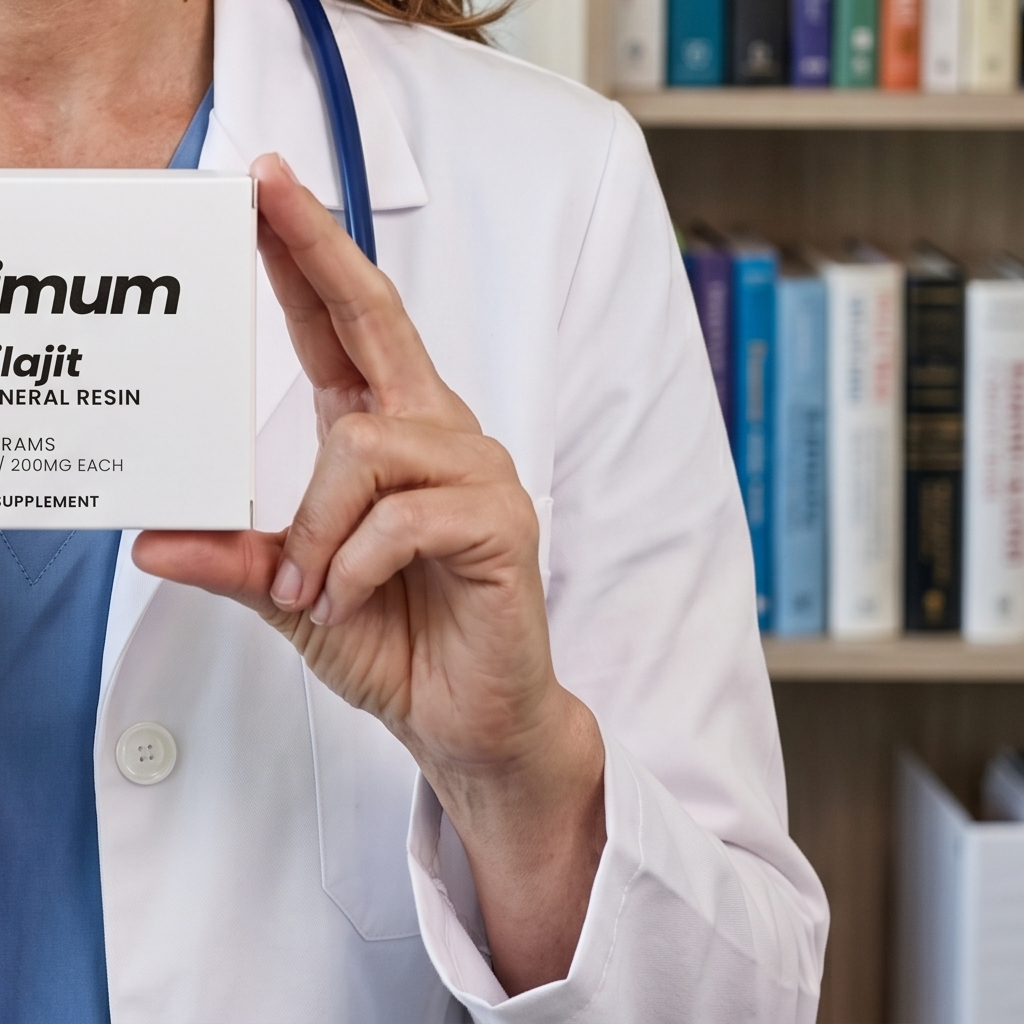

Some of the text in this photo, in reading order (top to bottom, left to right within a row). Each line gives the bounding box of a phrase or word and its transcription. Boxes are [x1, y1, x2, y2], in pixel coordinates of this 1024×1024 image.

[77, 389, 141, 406] RESIN
[10, 457, 72, 473] 200MG
[77, 457, 124, 473] EACH
